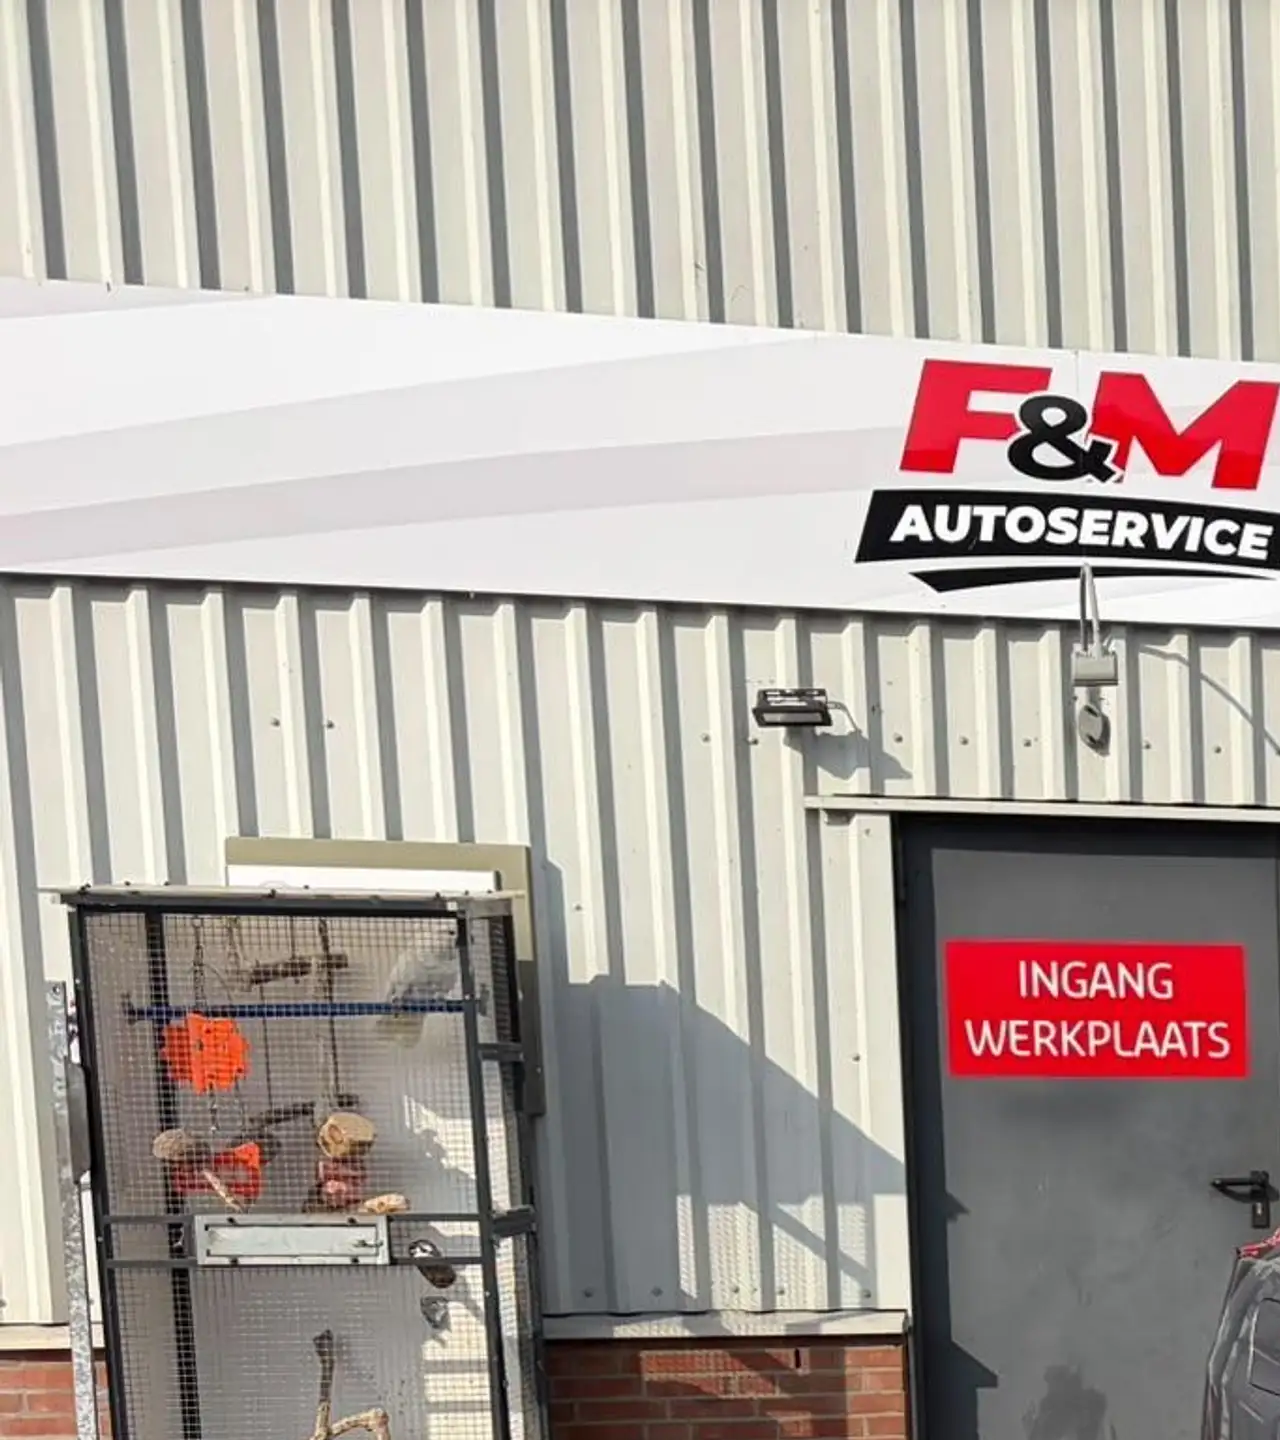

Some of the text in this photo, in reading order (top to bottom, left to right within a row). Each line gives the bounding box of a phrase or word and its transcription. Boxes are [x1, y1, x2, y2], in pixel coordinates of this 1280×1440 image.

[889, 504, 1273, 561] AUTOSERVICE
[1018, 960, 1174, 999] INGANG
[964, 1019, 1231, 1059] WERKPLAATS
